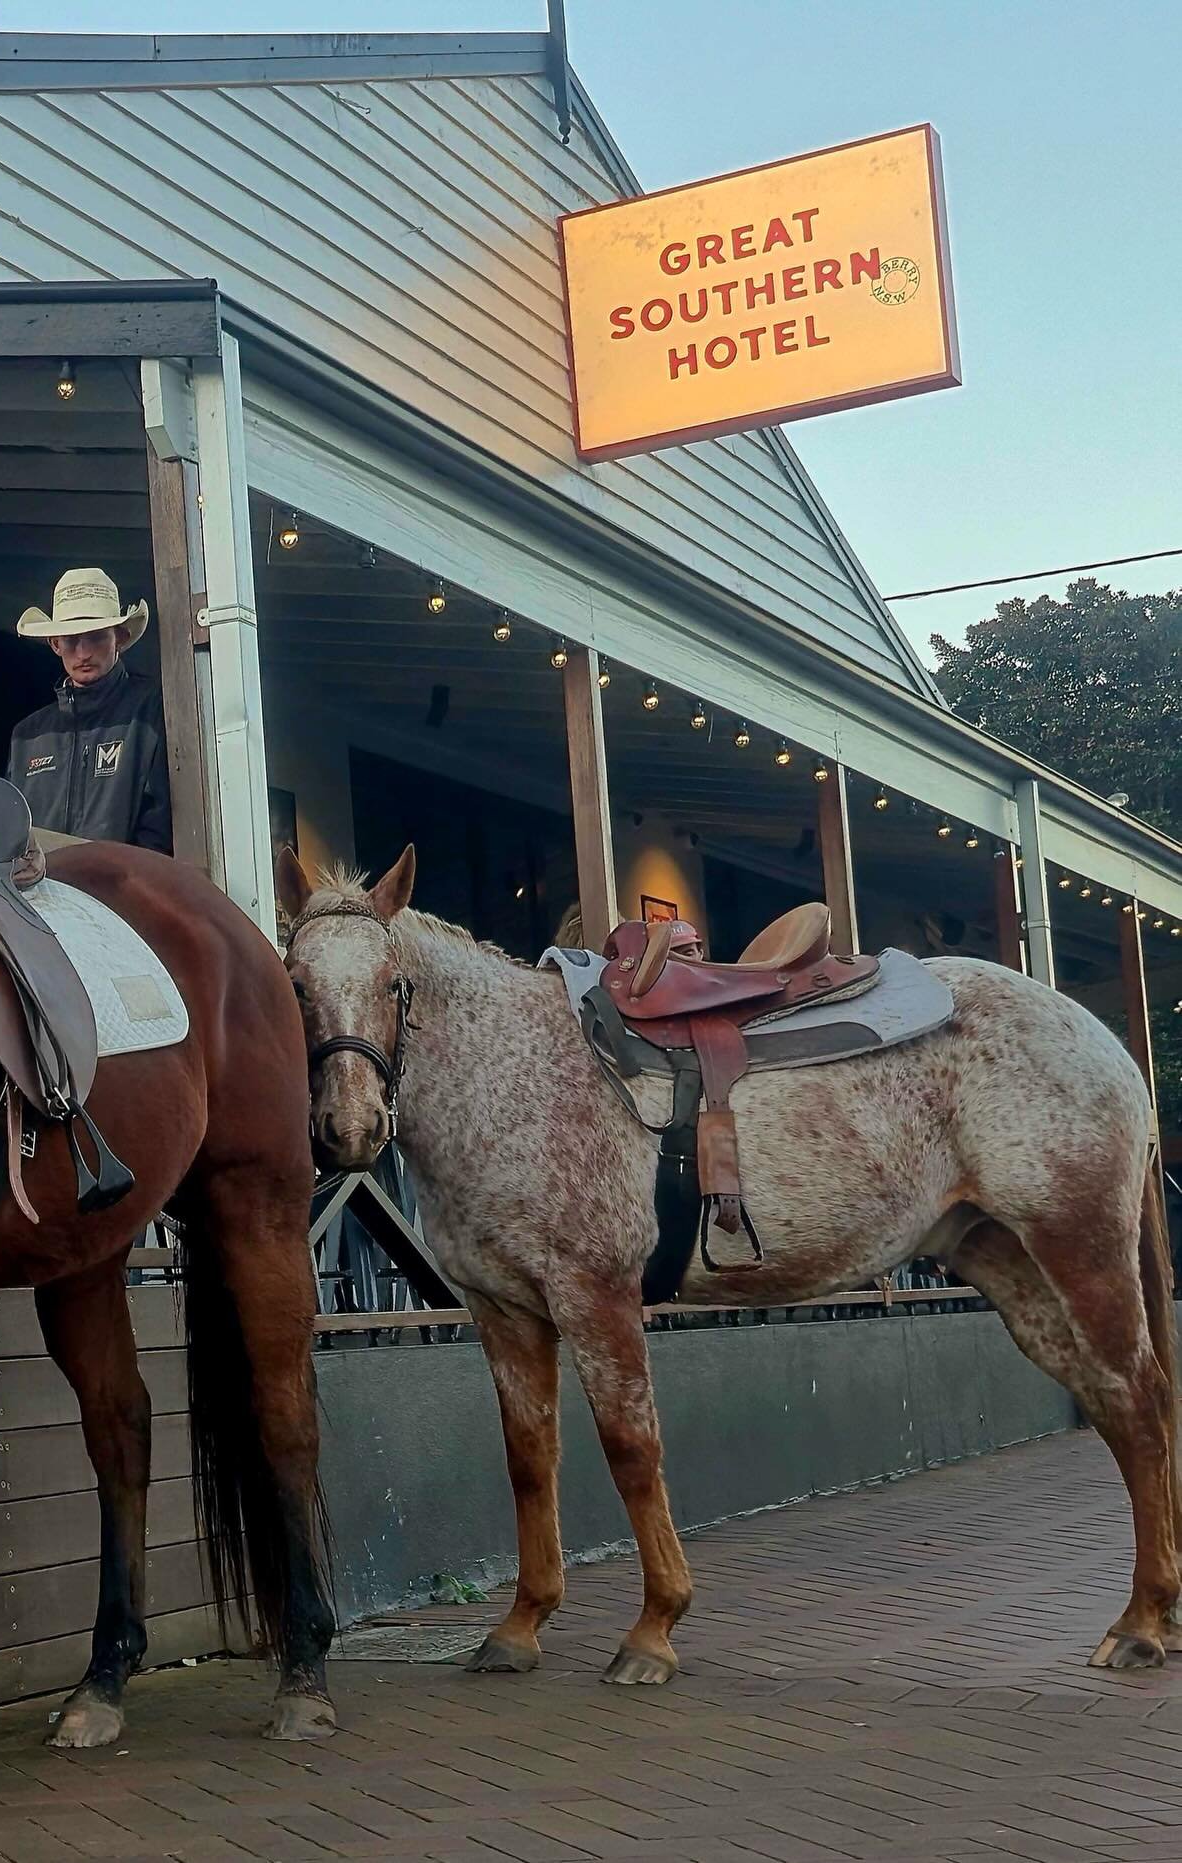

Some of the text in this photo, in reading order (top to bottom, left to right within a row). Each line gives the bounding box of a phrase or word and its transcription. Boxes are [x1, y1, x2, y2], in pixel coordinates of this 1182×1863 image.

[659, 208, 819, 275] GREAT
[881, 259, 918, 284] BERRY
[609, 247, 882, 340] SOUTHERN
[668, 315, 830, 379] HOTEL
